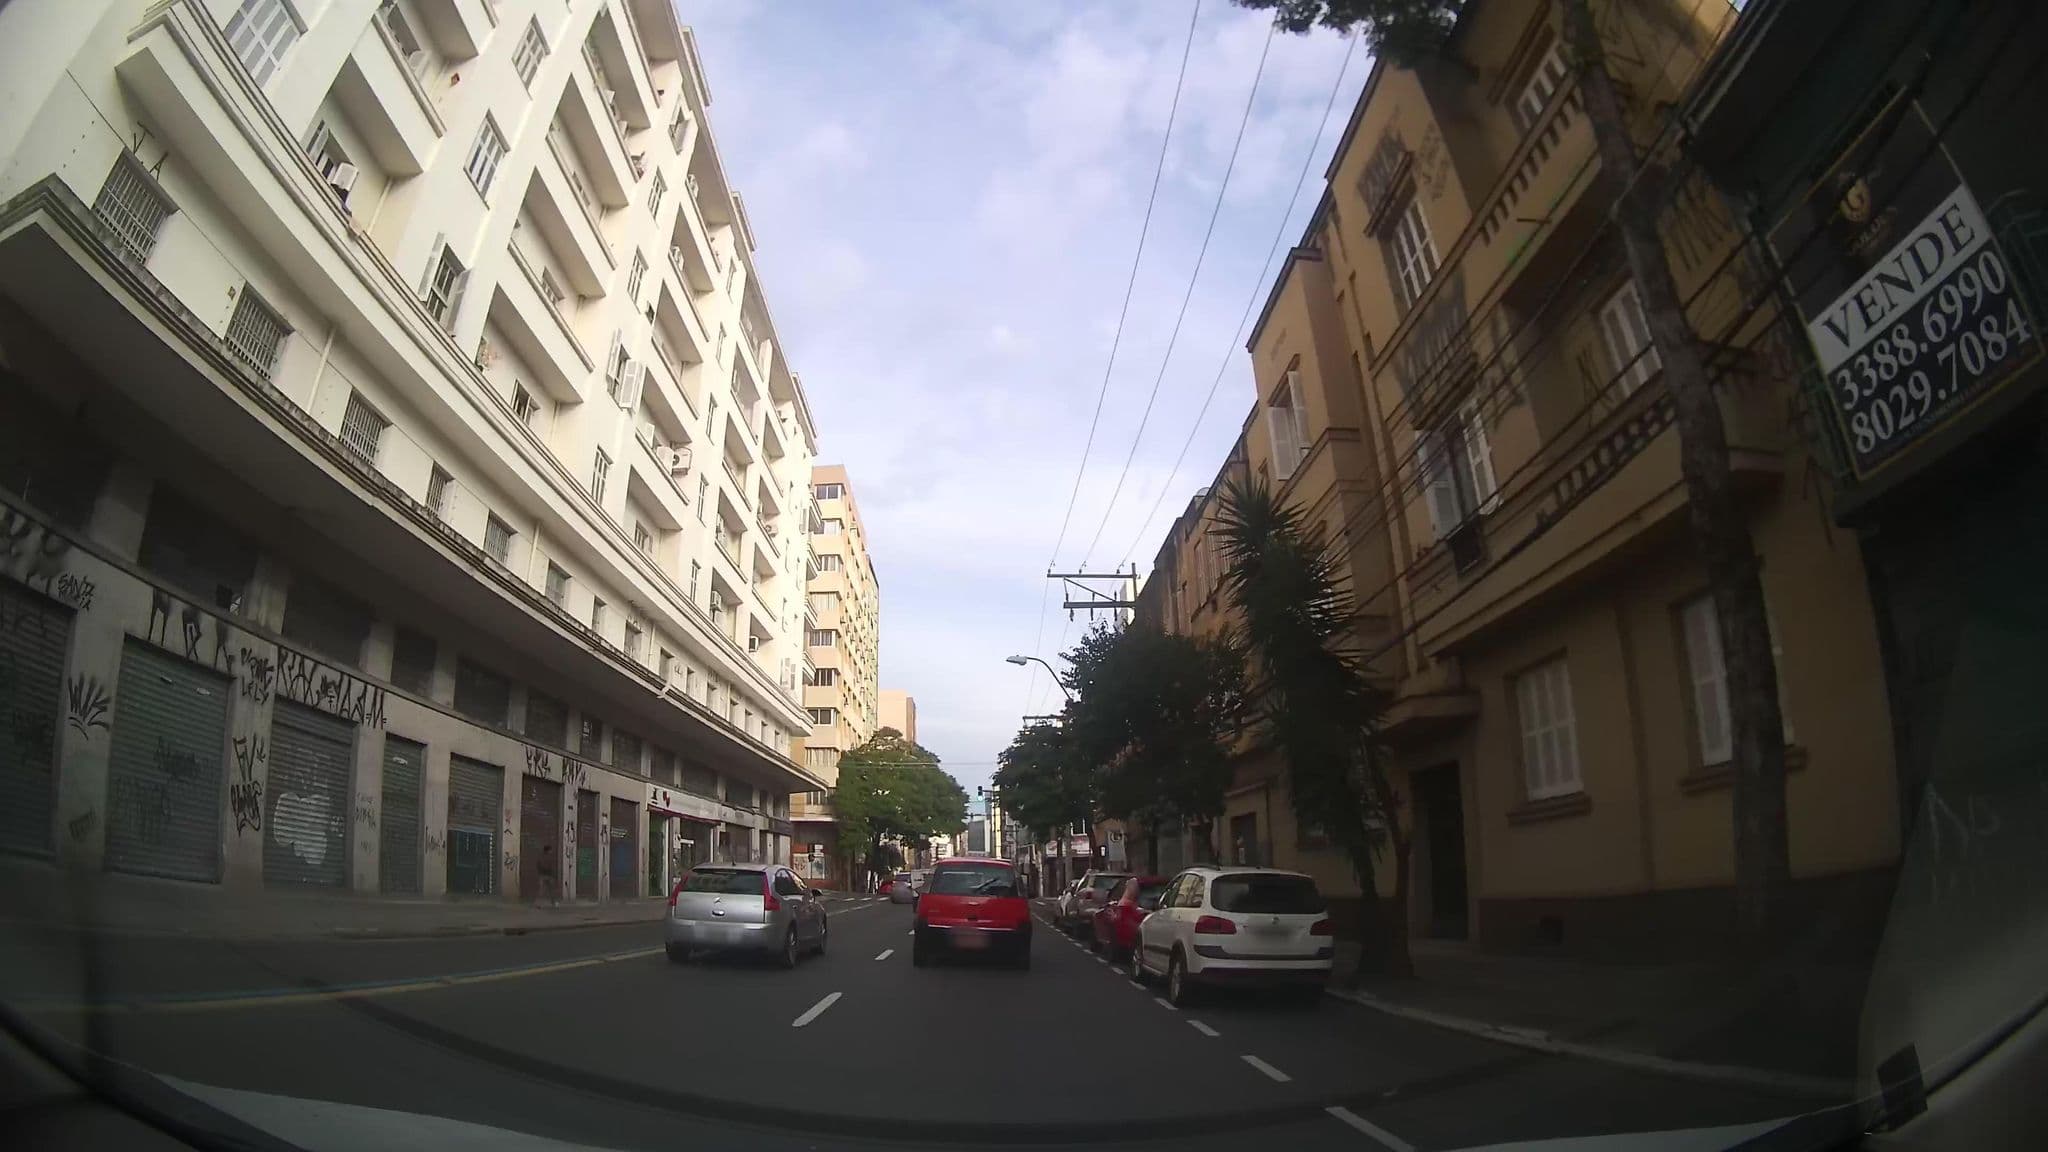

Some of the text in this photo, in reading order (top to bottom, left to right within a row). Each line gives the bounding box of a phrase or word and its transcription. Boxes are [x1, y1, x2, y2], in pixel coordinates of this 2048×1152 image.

[1823, 204, 1975, 349] VENDE
[1836, 250, 2005, 410] 3388.6990
[1851, 298, 2032, 454] 8029.7084
